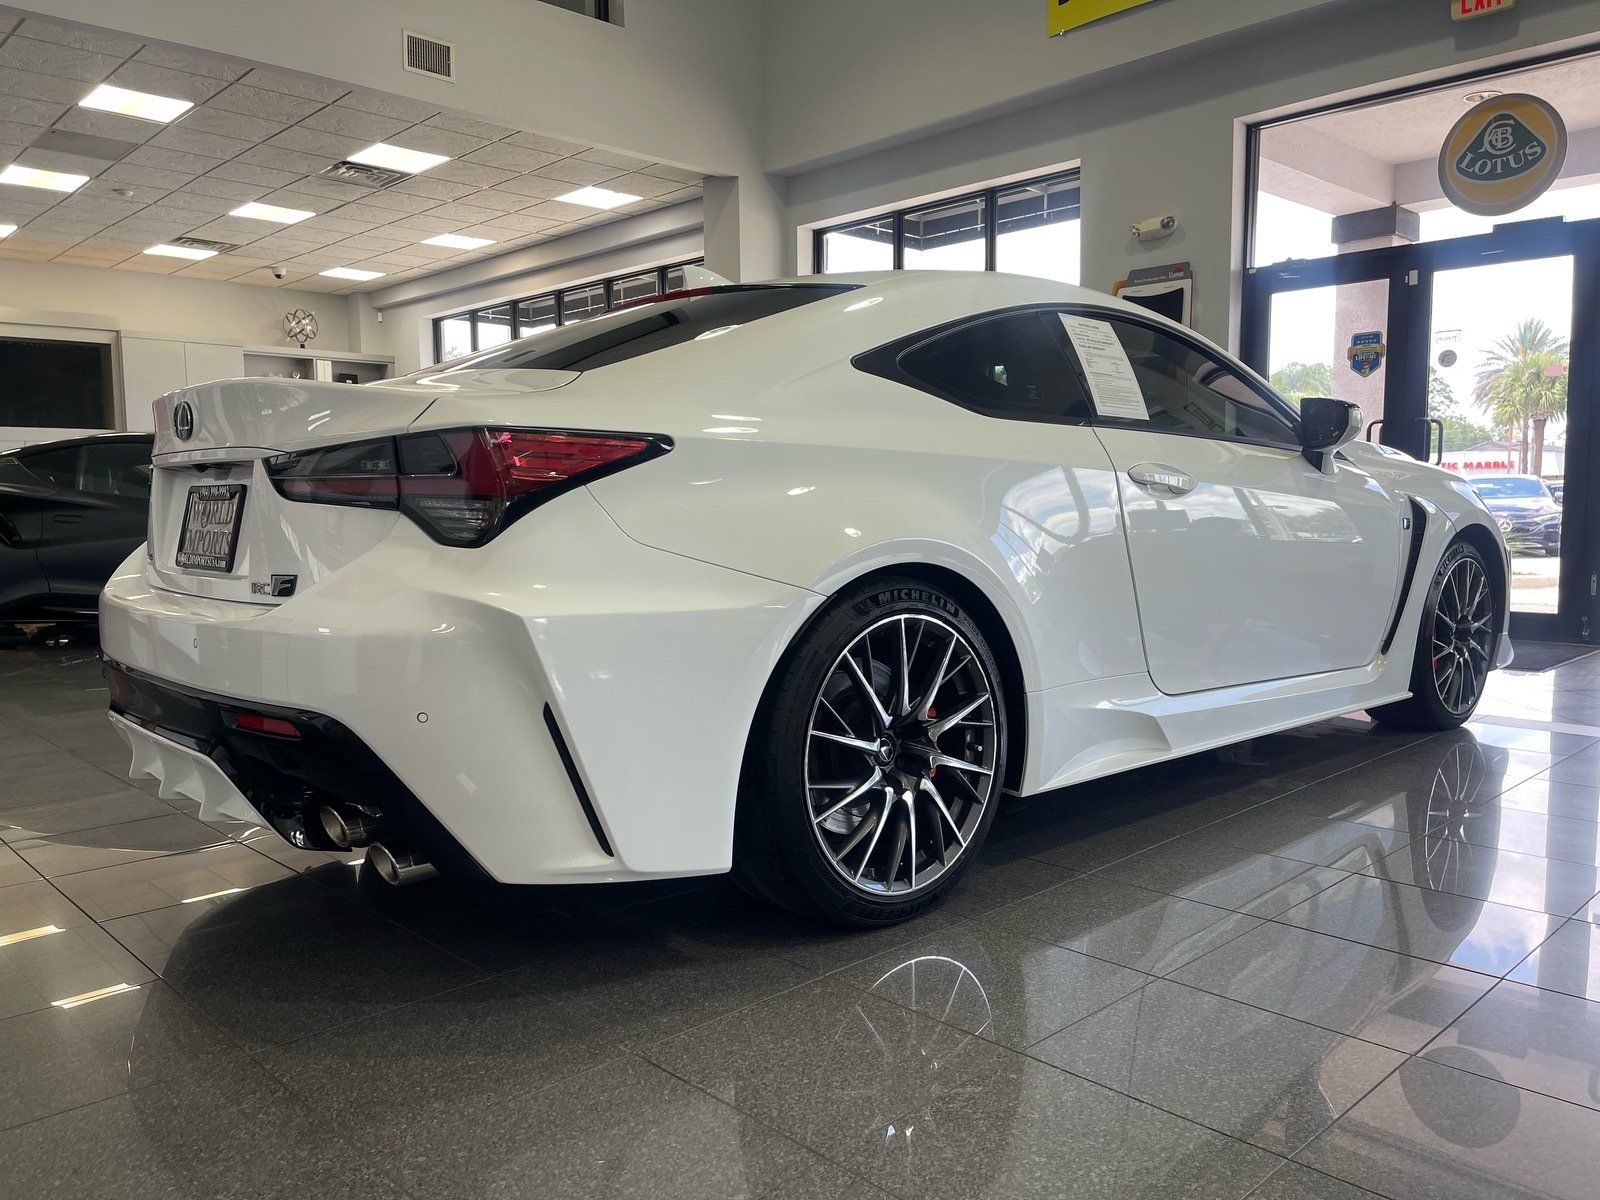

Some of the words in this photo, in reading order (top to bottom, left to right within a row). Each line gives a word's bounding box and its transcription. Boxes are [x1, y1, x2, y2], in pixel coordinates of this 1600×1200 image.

[1459, 141, 1542, 175] LOTUS
[1463, 461, 1515, 470] MARBLE
[192, 500, 236, 529] WORLD
[183, 530, 233, 556] IMPORTS
[878, 588, 956, 614] MICHELIN
